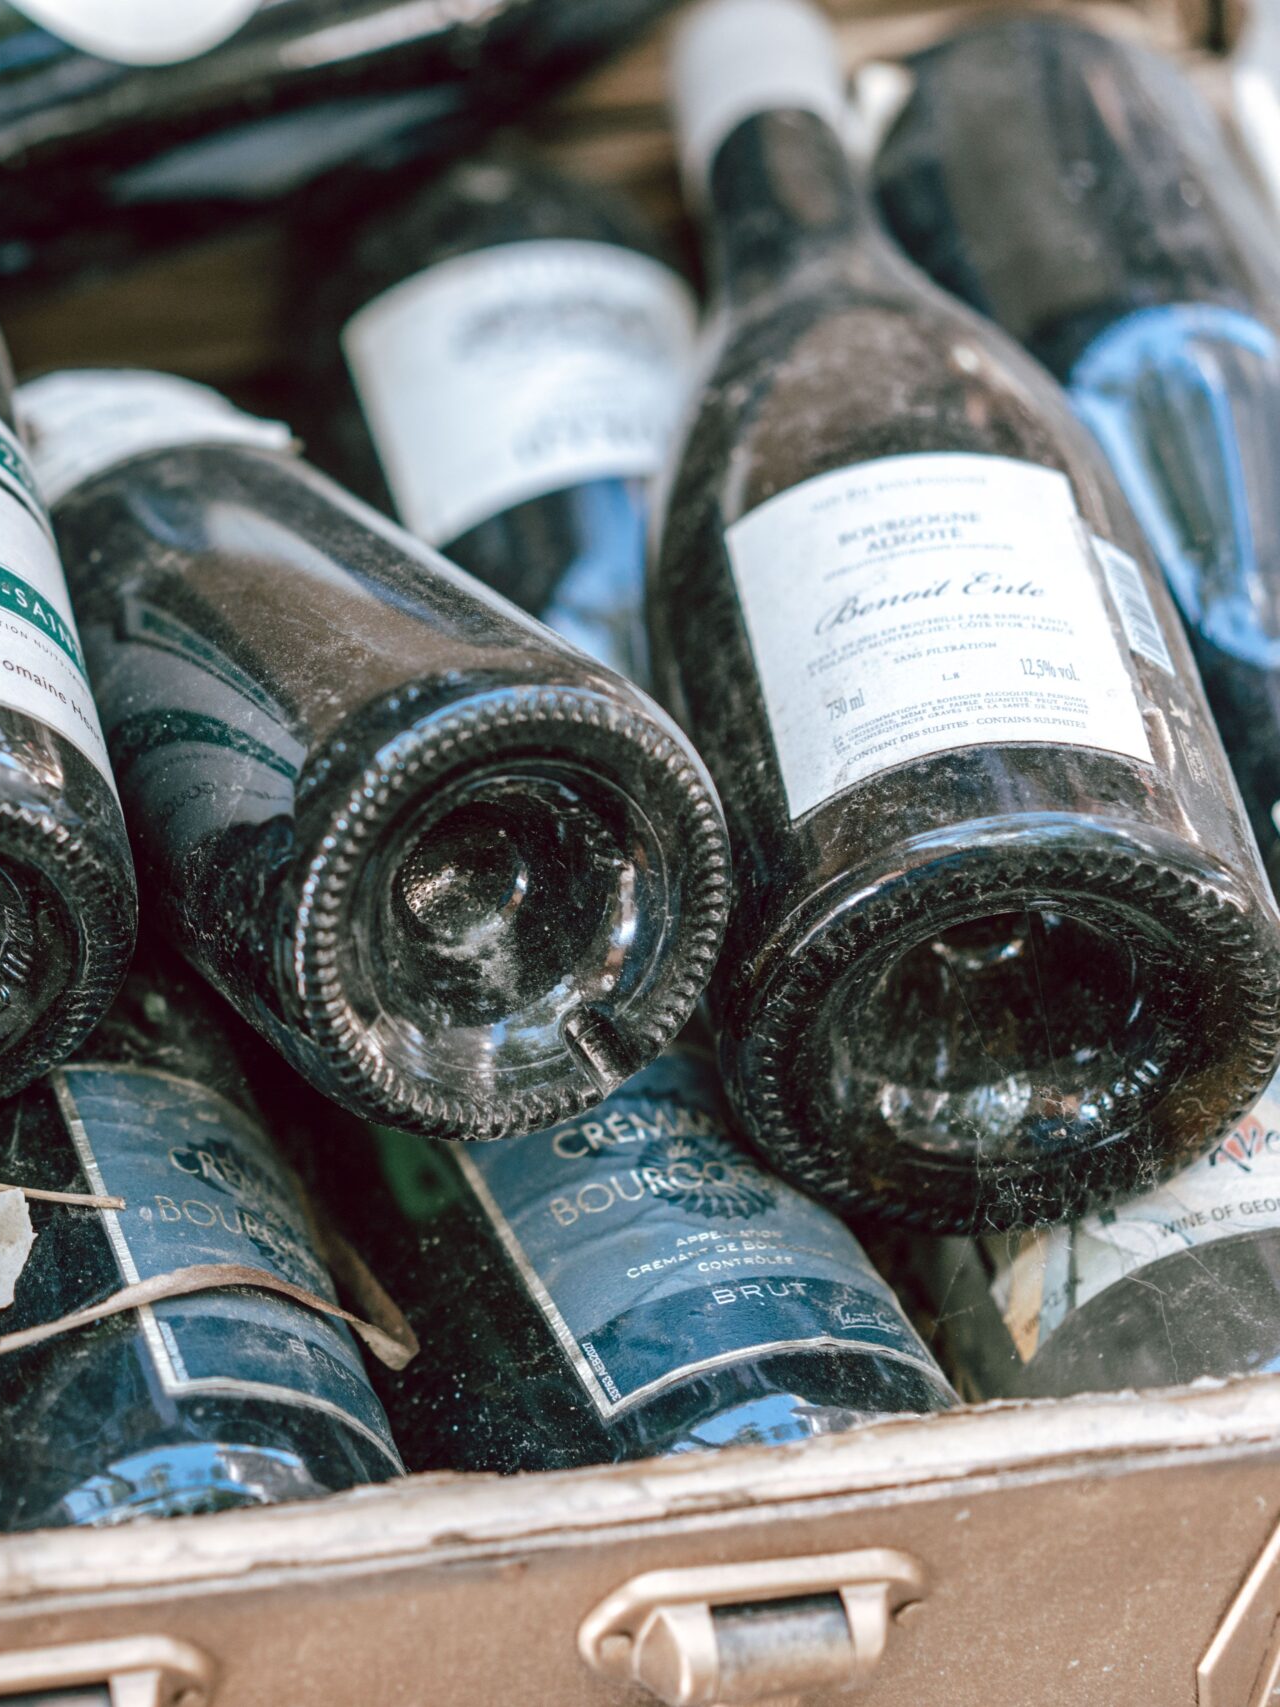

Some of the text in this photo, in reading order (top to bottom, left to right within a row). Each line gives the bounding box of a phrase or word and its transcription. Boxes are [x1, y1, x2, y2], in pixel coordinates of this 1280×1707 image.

[814, 578, 951, 637] Benoit
[1019, 658, 1057, 679] 12,5%
[826, 688, 866, 721] 750 ml
[846, 716, 1087, 765] CONTIENT DES SULFITES CONTAINS SULPHITES
[1158, 1197, 1280, 1238] WINE OF GEO
[715, 1242, 739, 1253] DE
[711, 1281, 808, 1305] BRUT
[581, 1341, 609, 1377] AEB2027
